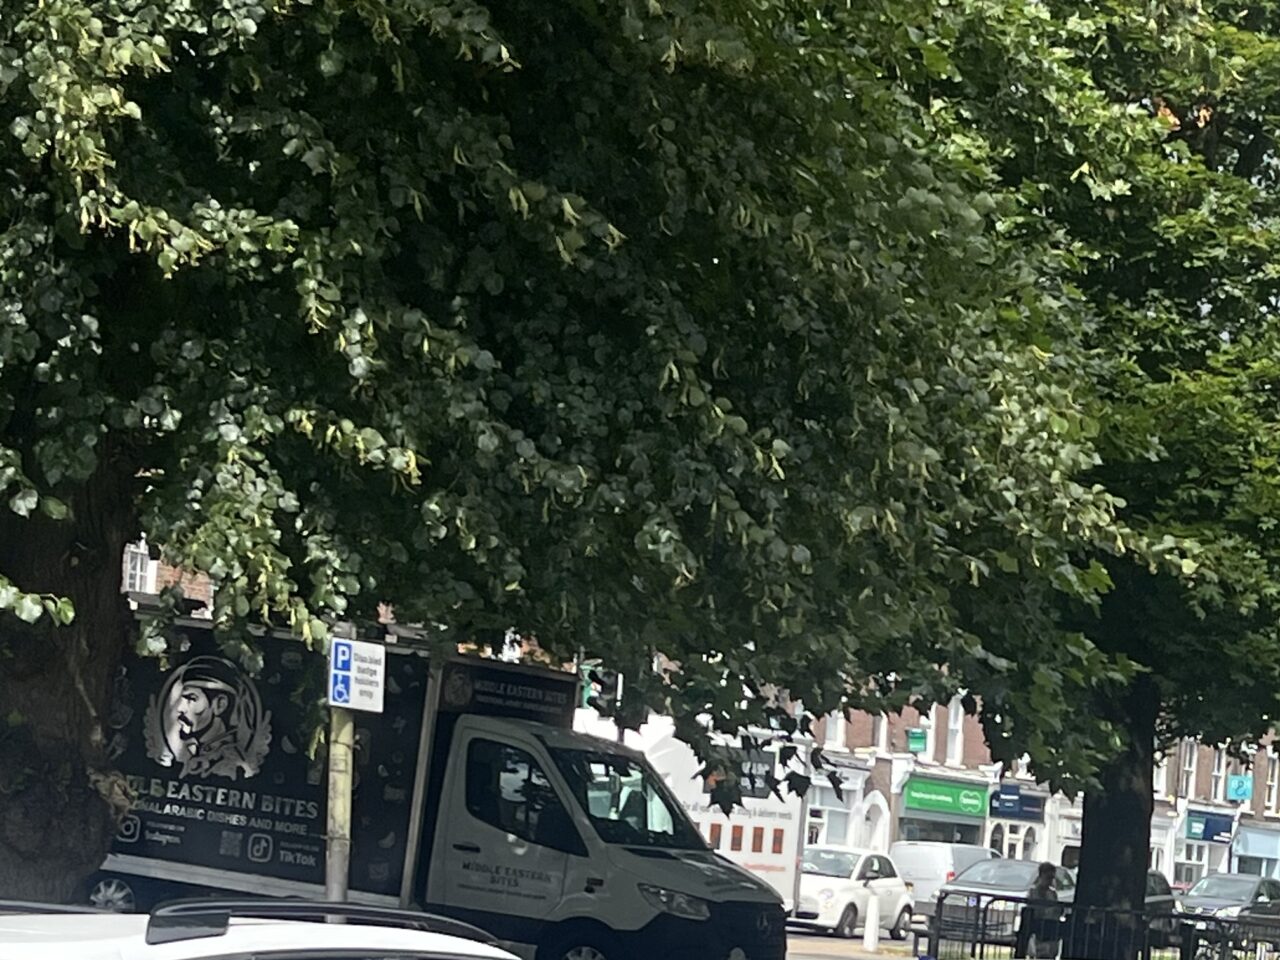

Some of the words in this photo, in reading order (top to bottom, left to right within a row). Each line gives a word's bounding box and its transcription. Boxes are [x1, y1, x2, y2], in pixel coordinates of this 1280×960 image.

[337, 645, 350, 668] P
[166, 780, 256, 810] EASTERN
[261, 795, 319, 819] BITES
[163, 804, 205, 821] ARABIC
[207, 811, 247, 827] DISHES
[250, 817, 273, 830] AND
[274, 820, 308, 836] MORE
[279, 850, 317, 867] TikTok
[462, 861, 501, 875] MIDDLE
[504, 866, 551, 883] EASTERN
